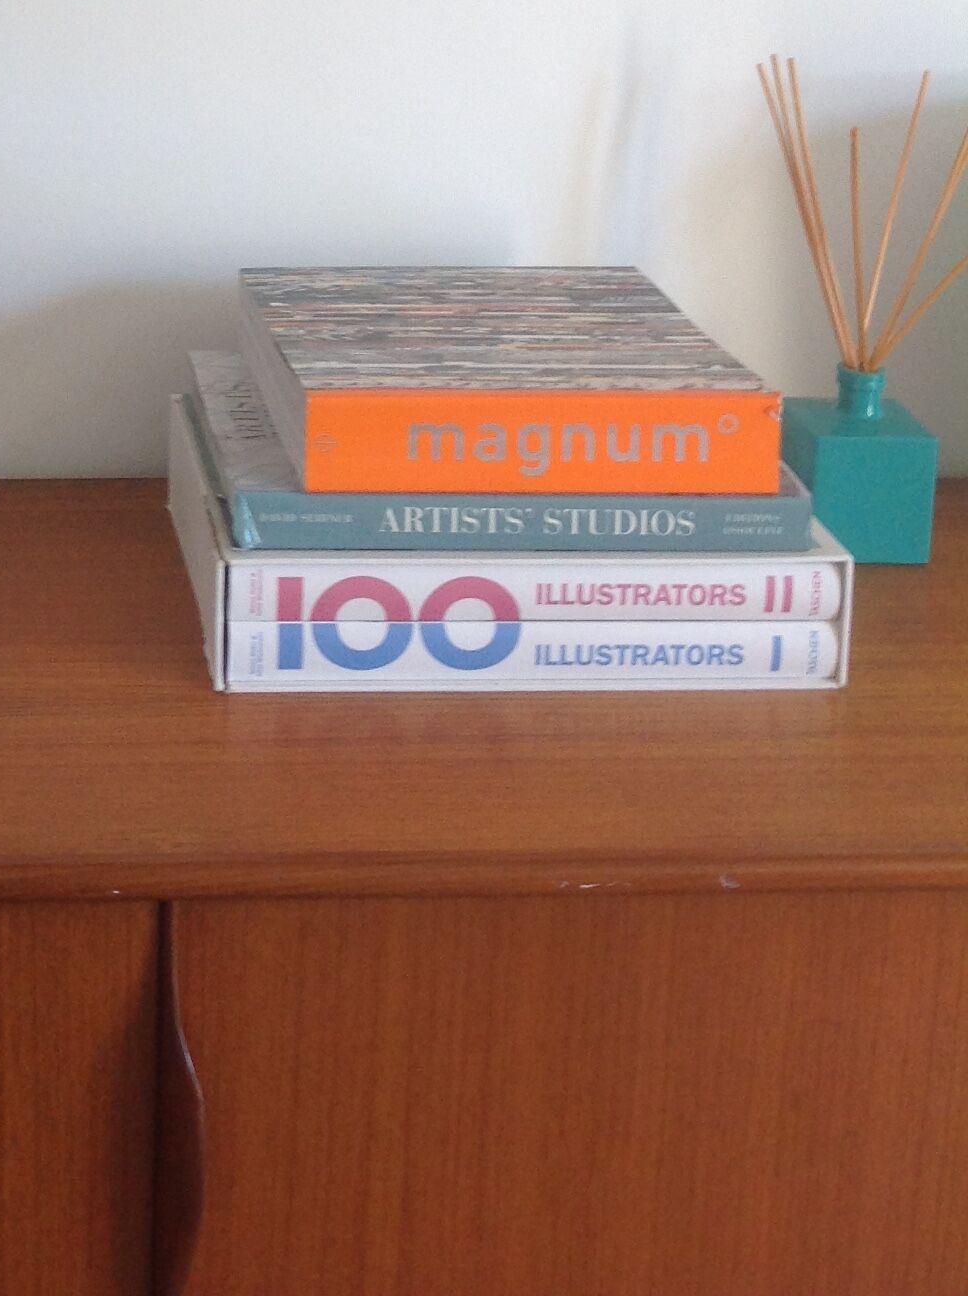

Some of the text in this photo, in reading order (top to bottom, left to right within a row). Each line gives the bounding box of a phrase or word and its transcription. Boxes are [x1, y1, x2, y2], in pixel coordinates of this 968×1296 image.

[542, 507, 696, 536] STUDIOS
[535, 582, 747, 606] ILLUSTRATORS
[534, 643, 745, 666] ILLUSTRATORS
